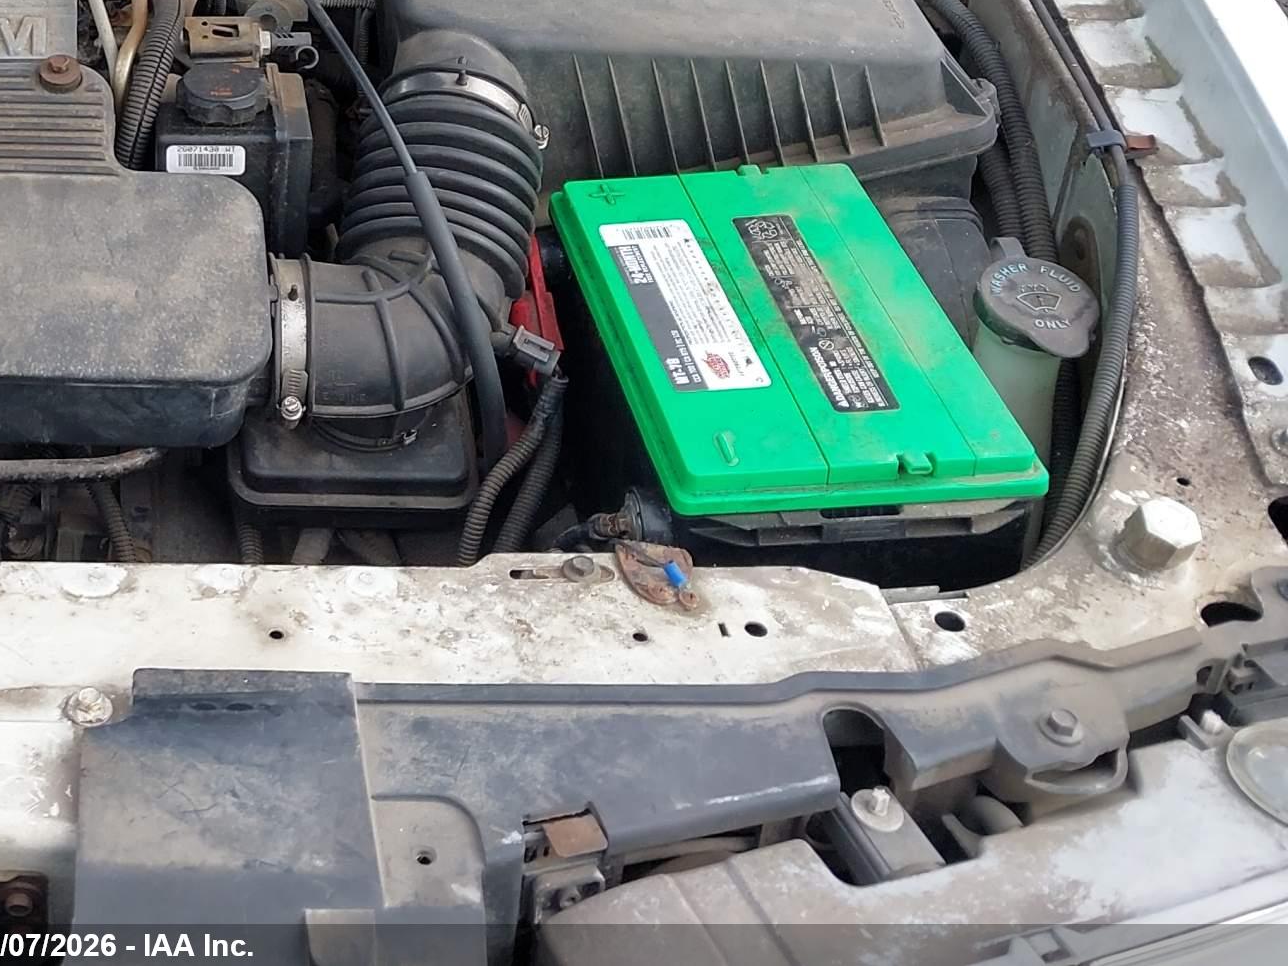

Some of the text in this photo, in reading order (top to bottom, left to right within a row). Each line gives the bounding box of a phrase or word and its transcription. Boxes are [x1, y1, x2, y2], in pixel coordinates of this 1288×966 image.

[617, 245, 648, 283] 24-MONTH
[991, 263, 1081, 296] WASHER FLUID
[1034, 318, 1073, 329] ONLY
